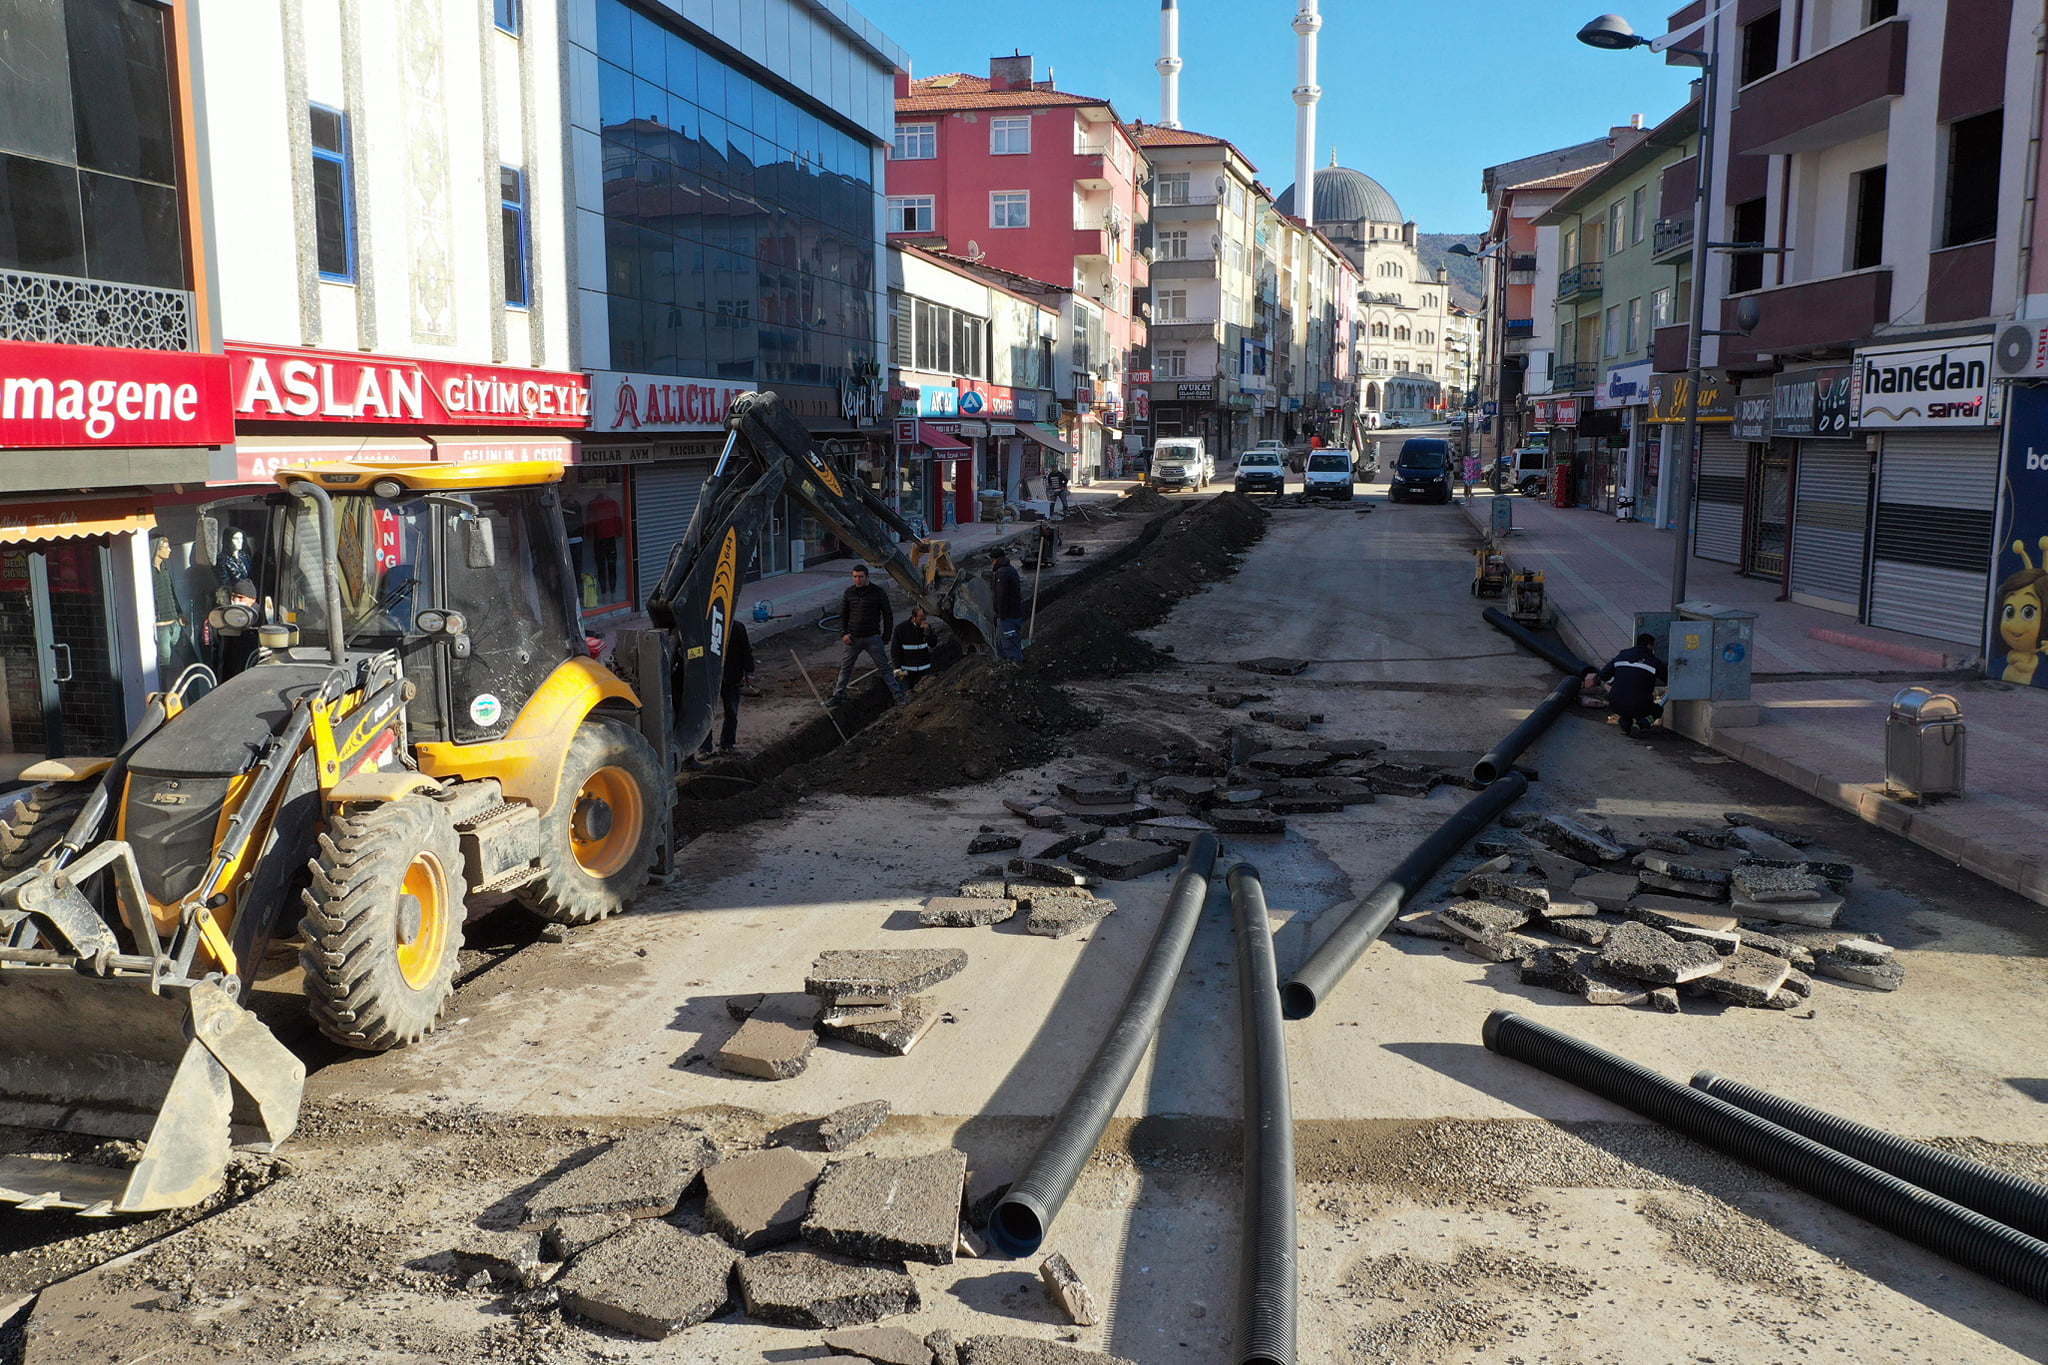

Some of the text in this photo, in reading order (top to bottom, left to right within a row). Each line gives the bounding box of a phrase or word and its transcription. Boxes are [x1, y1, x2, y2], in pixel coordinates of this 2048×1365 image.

[1132, 373, 1150, 382] NOTER
[1865, 353, 1985, 394] hanedan
[238, 357, 425, 419] ASLAN
[1670, 377, 1720, 417] Yar
[0, 377, 199, 439] magene
[645, 383, 745, 422] ALICILA
[1927, 396, 1983, 418] sarraf
[521, 447, 529, 461] &
[630, 449, 649, 460] AVM
[669, 444, 706, 456] ALICILAR
[808, 452, 824, 467] MST
[330, 474, 356, 483] MST
[725, 536, 734, 560] 644
[710, 605, 724, 656] MST
[374, 692, 394, 723] MST
[152, 793, 191, 804] MST
